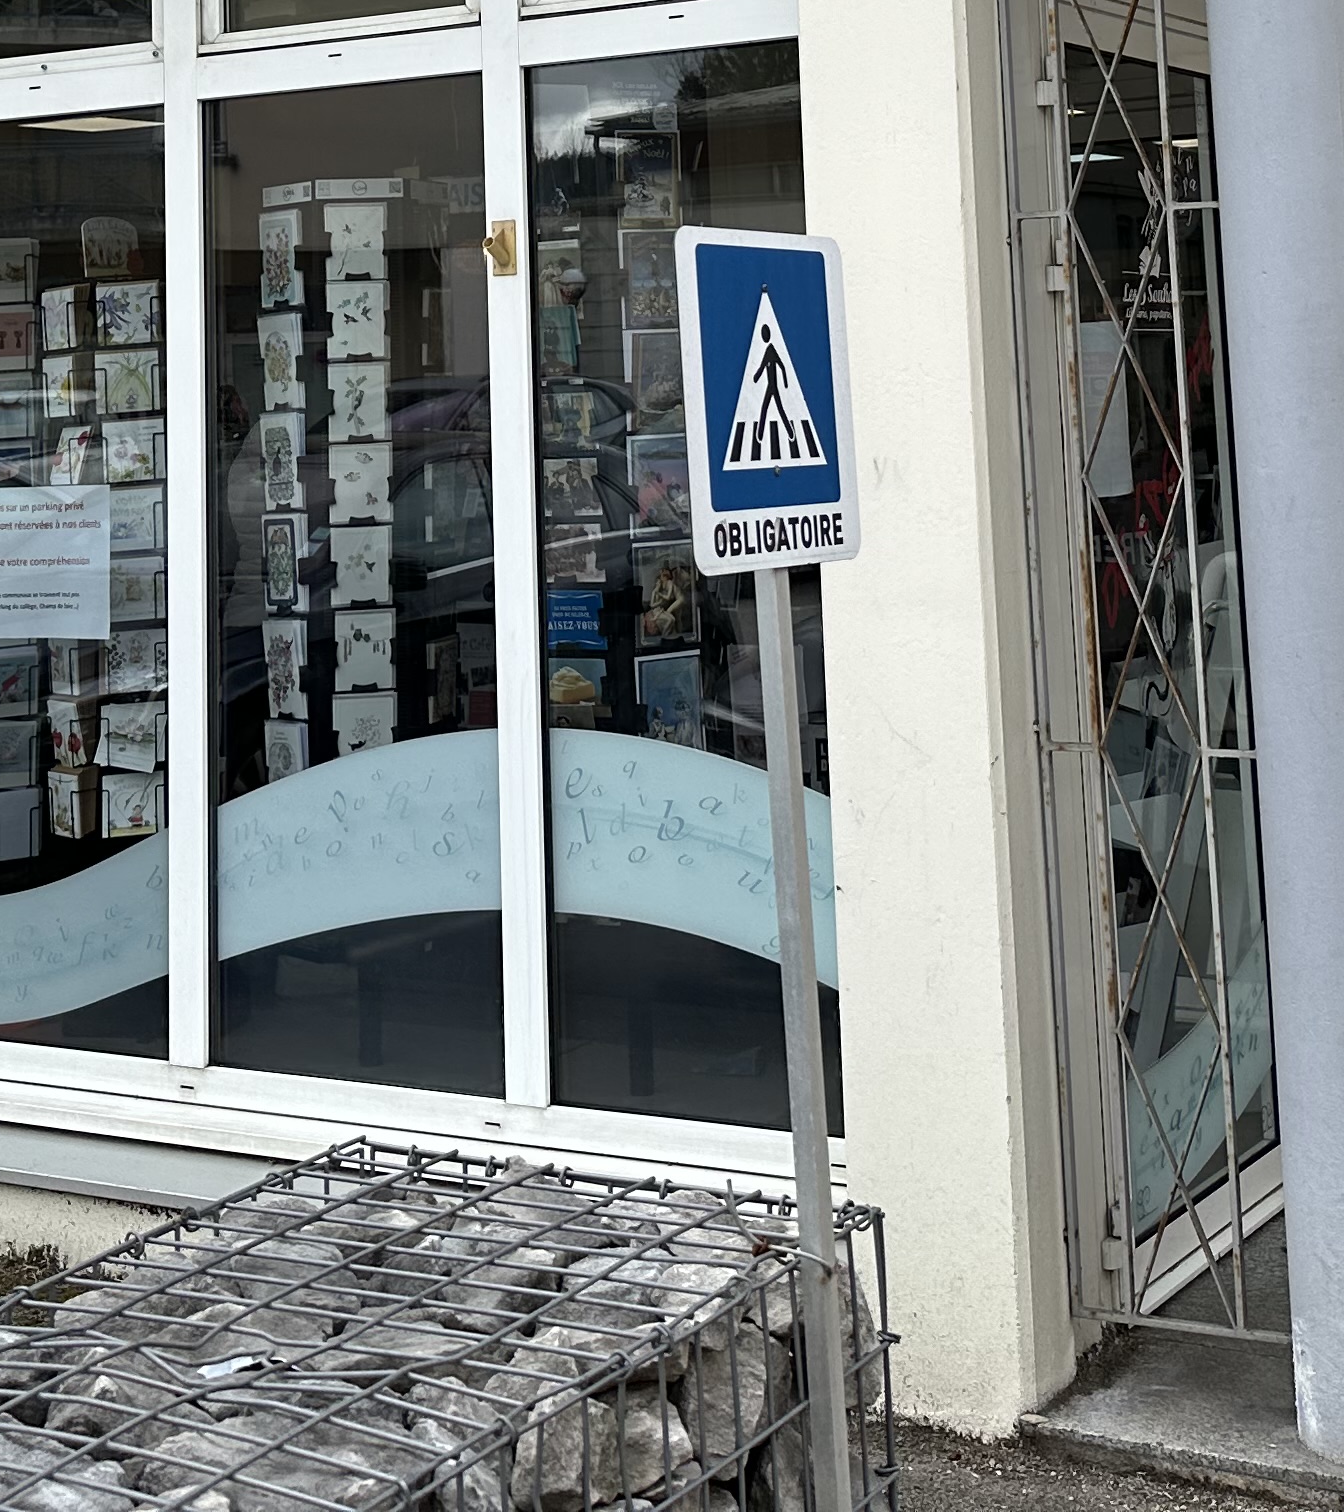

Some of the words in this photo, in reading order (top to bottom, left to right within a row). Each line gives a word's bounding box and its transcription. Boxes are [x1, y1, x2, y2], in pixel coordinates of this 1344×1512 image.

[6, 504, 18, 512] sur
[19, 504, 30, 512] un
[31, 502, 63, 513] parking
[64, 500, 85, 512] privé
[14, 520, 54, 530] réservées
[62, 521, 77, 529] nos
[78, 519, 101, 529] clients
[714, 512, 844, 558] OBLIGATOIRE
[6, 557, 27, 566] votre
[29, 555, 90, 567] compréhension
[548, 620, 599, 631] AISEZ-VOUS
